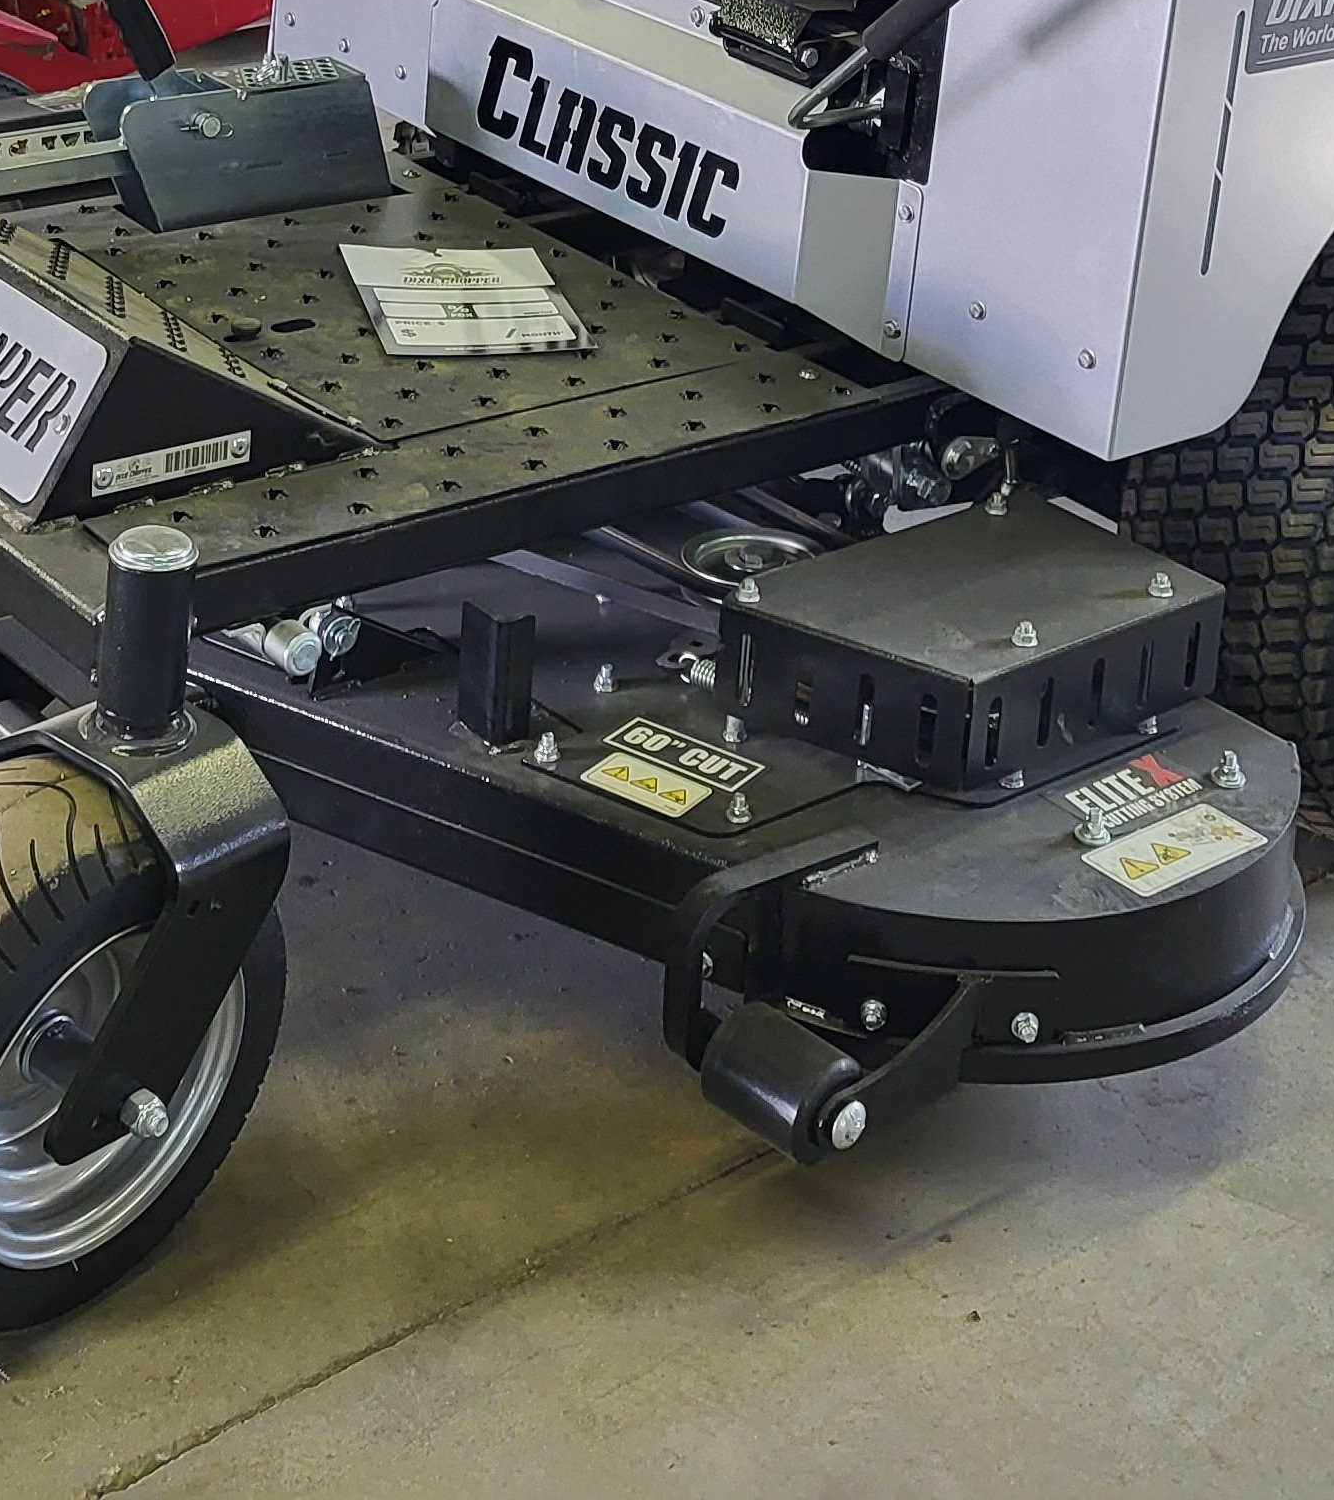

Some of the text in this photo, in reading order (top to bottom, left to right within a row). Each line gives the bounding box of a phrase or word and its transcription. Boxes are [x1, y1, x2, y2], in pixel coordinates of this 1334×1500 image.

[1261, 33, 1287, 54] The
[476, 35, 740, 239] CLASSIC
[622, 726, 749, 781] 60" CUT
[1128, 754, 1184, 788] X
[1101, 777, 1204, 829] CUTTING SYSTEM
